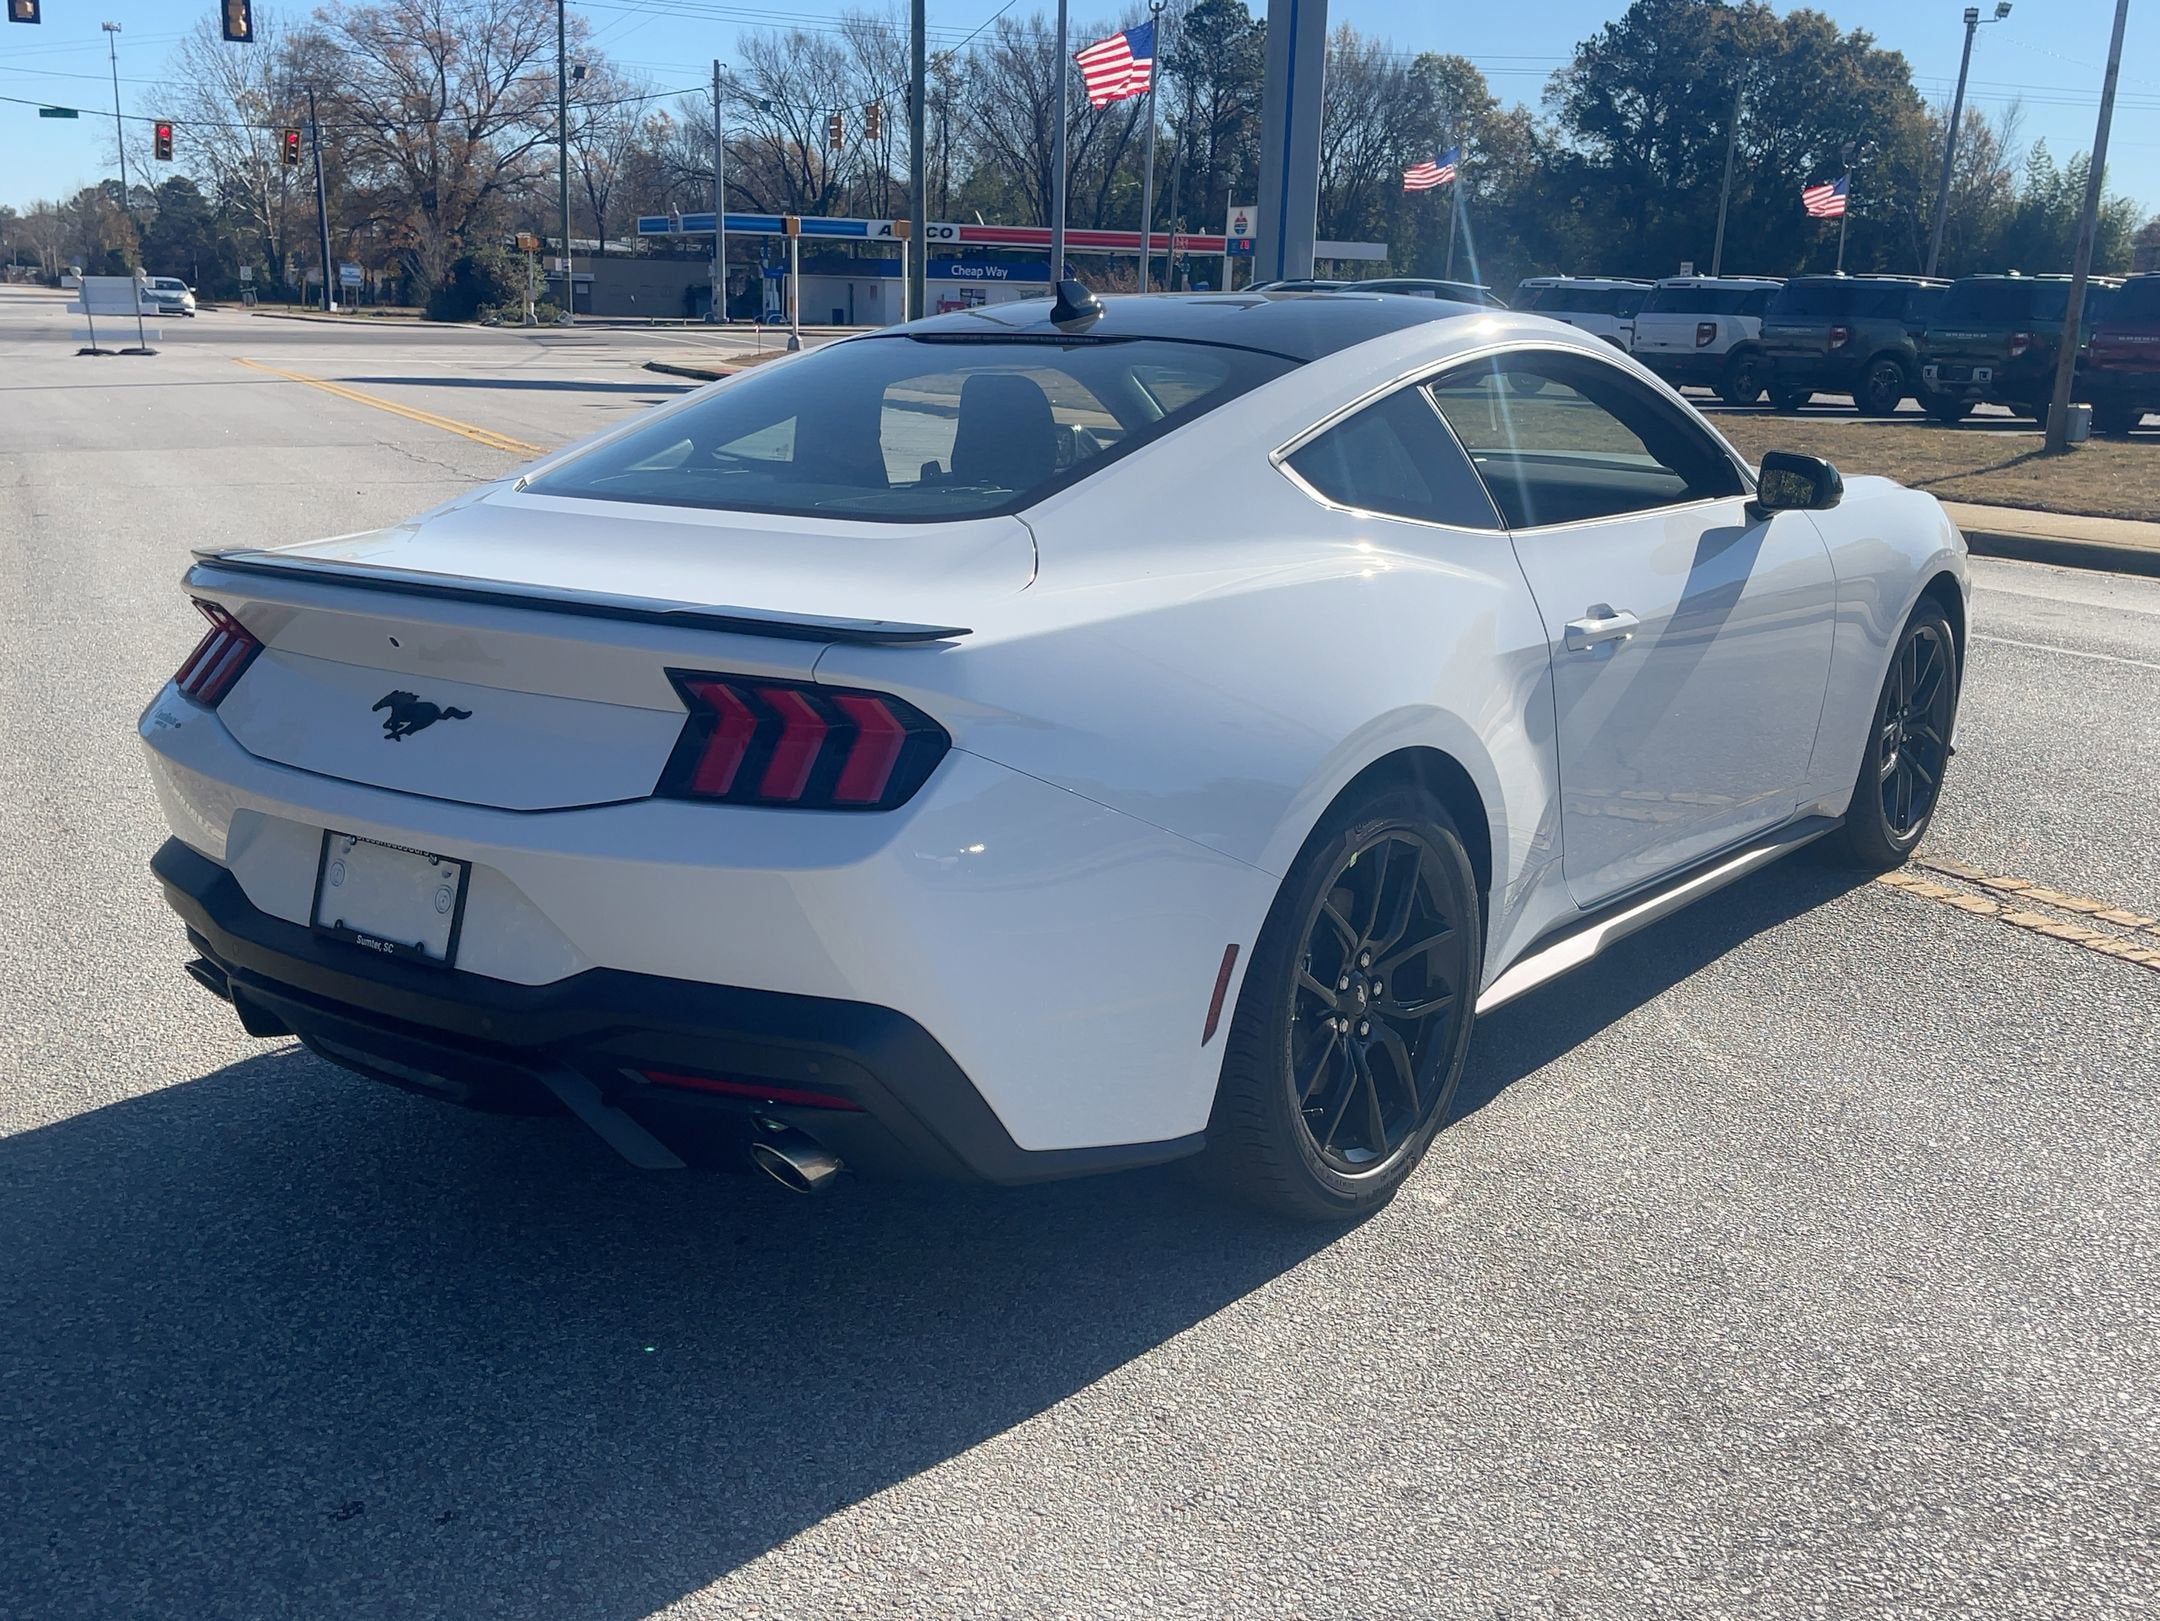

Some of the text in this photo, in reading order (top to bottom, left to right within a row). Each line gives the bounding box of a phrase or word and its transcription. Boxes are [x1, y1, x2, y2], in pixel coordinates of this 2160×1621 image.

[878, 225, 953, 239] ACO
[951, 264, 1008, 280] Cheap Way
[356, 934, 394, 953] Sumter, SC
